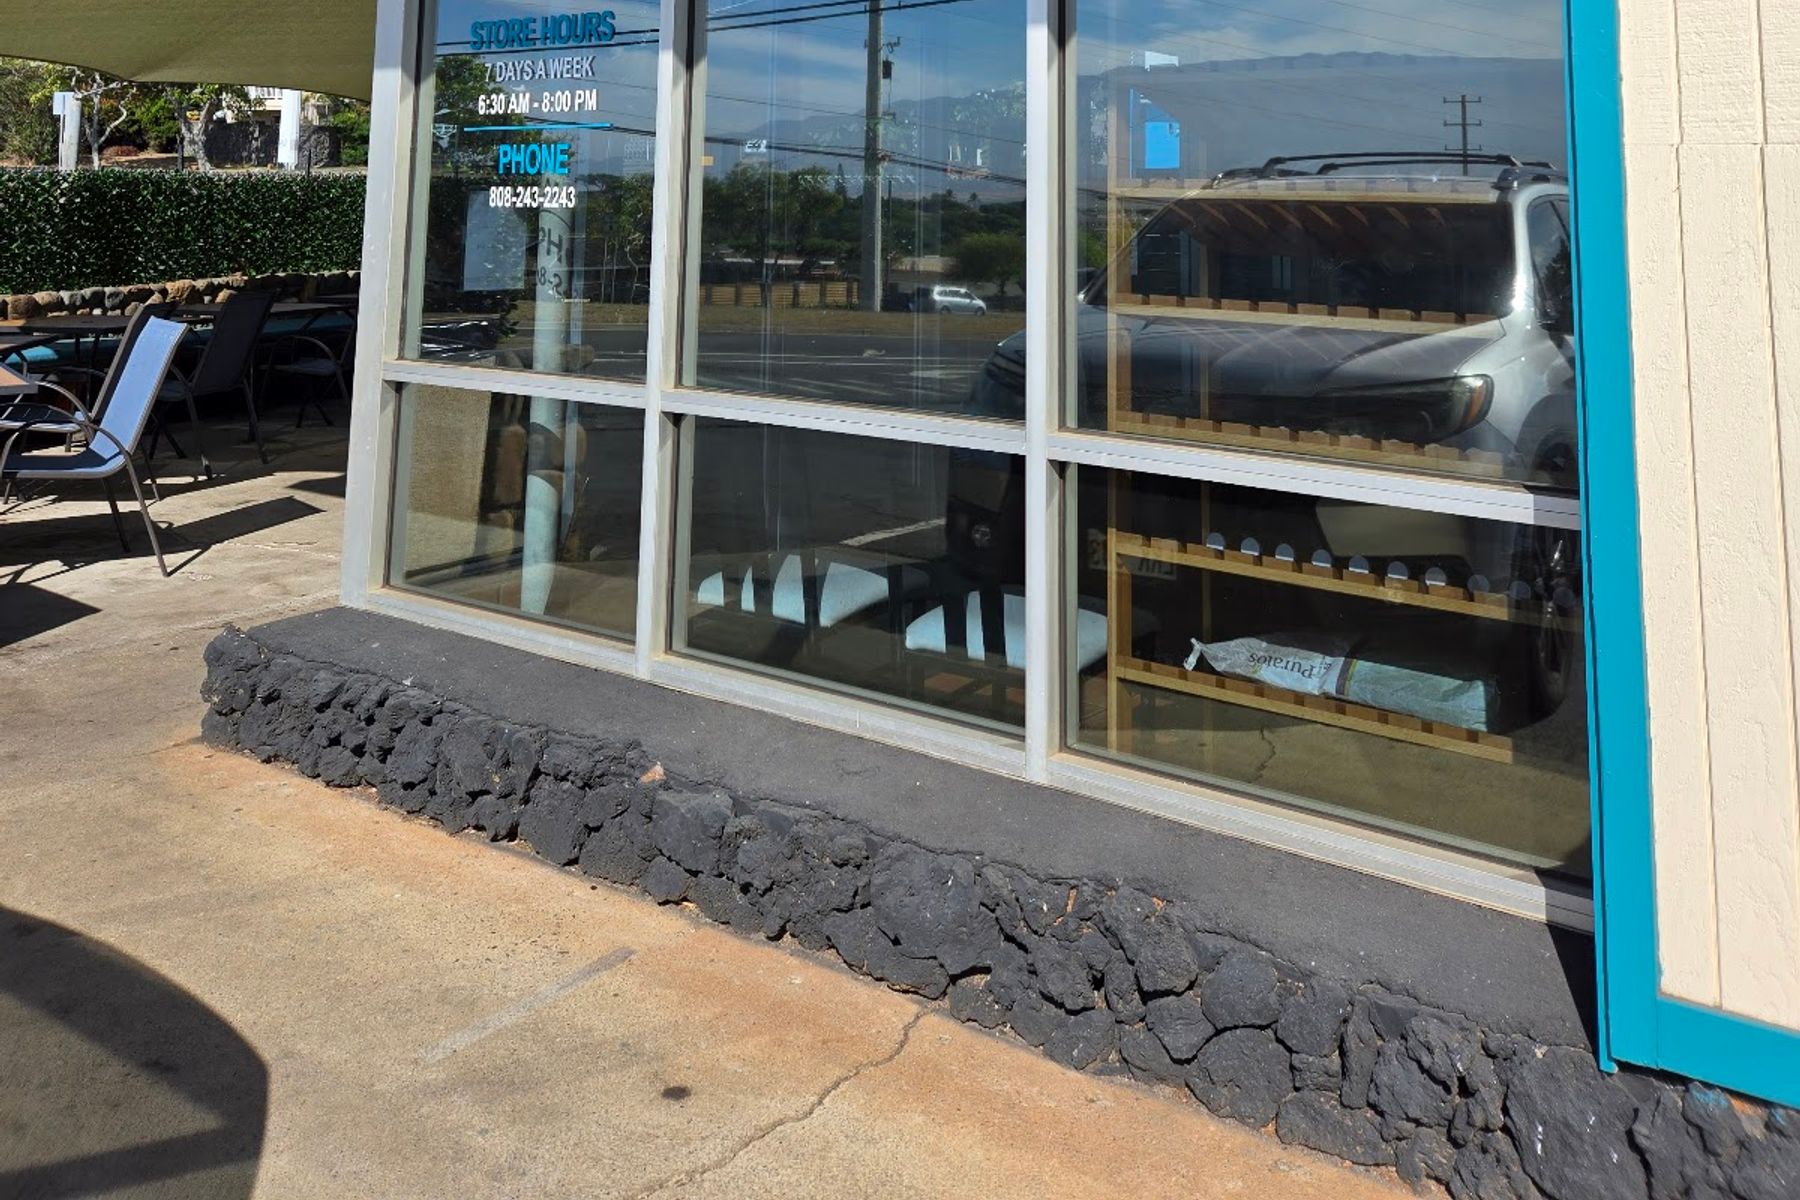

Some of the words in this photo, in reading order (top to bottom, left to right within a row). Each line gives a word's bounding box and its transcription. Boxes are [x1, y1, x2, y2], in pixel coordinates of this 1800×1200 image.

[470, 16, 537, 51] STORE
[540, 10, 617, 46] HOURS
[485, 62, 493, 83] 7
[496, 59, 534, 82] DAYS
[535, 58, 548, 80] A
[549, 55, 598, 80] WEEK
[478, 93, 506, 116] 6:30
[507, 91, 531, 115] AM
[541, 89, 572, 113] 8:00
[574, 88, 598, 112] PM
[498, 142, 571, 176] PHONE
[488, 185, 577, 209] 808-243-2243
